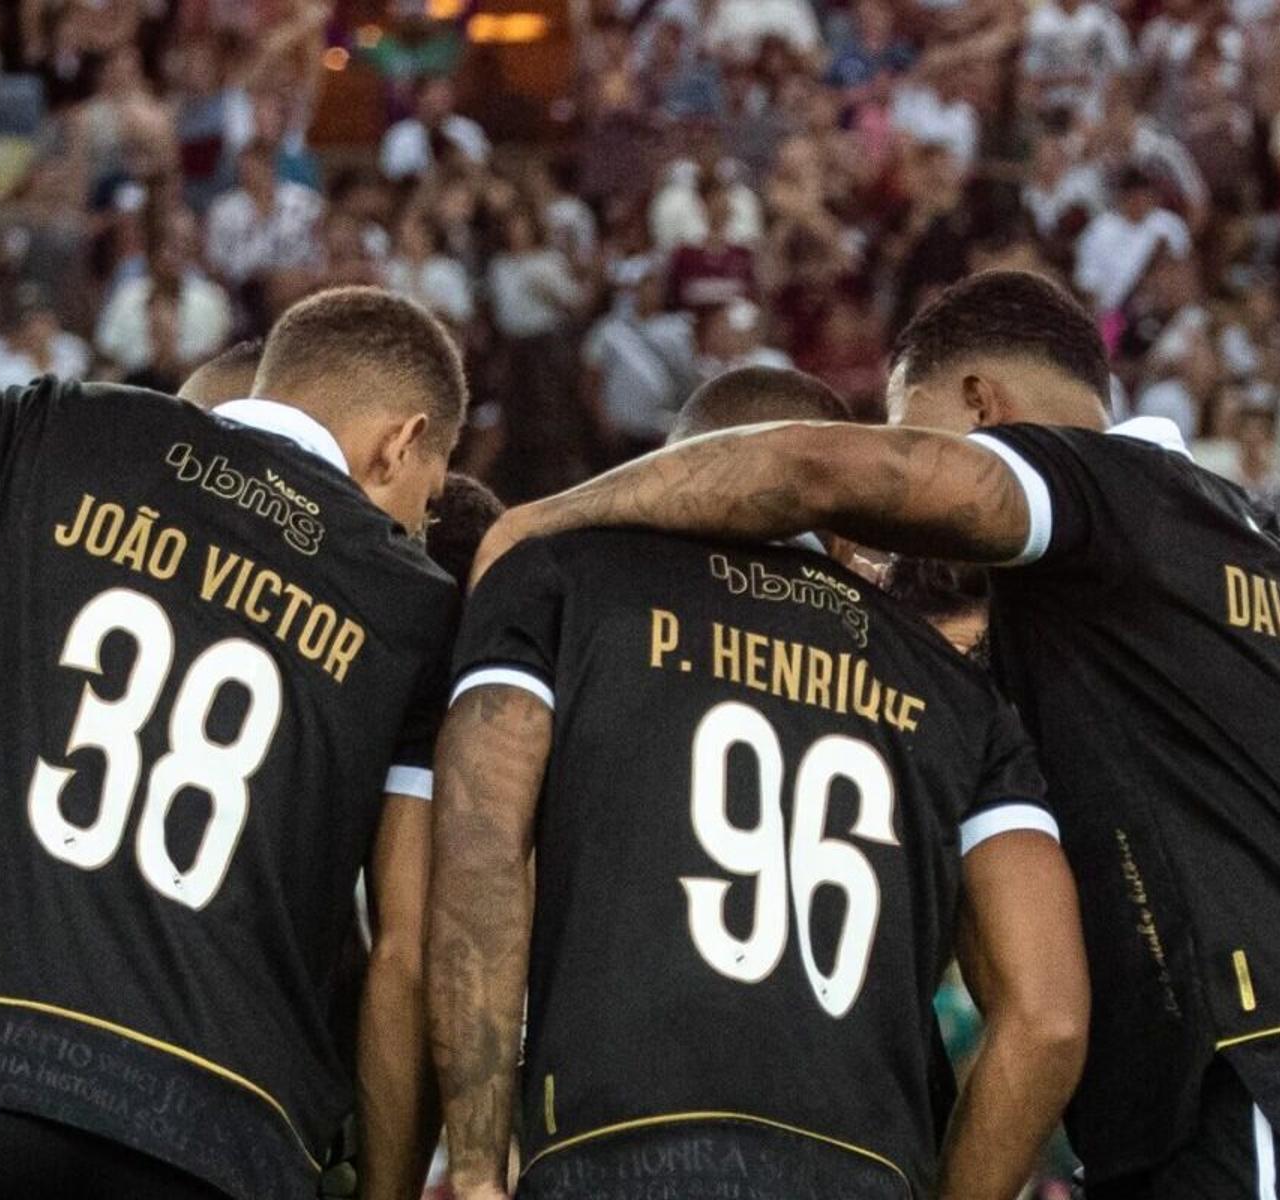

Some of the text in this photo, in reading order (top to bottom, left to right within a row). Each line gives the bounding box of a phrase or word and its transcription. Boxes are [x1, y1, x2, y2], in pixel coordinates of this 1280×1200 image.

[201, 456, 325, 556] bmg
[265, 468, 320, 516] VASCO
[54, 493, 366, 685] JOÃO VICTOR
[751, 562, 870, 649] bmg
[801, 565, 862, 603] VASCO
[650, 608, 692, 672] P.
[27, 587, 283, 912] 38
[677, 699, 902, 1021] 96
